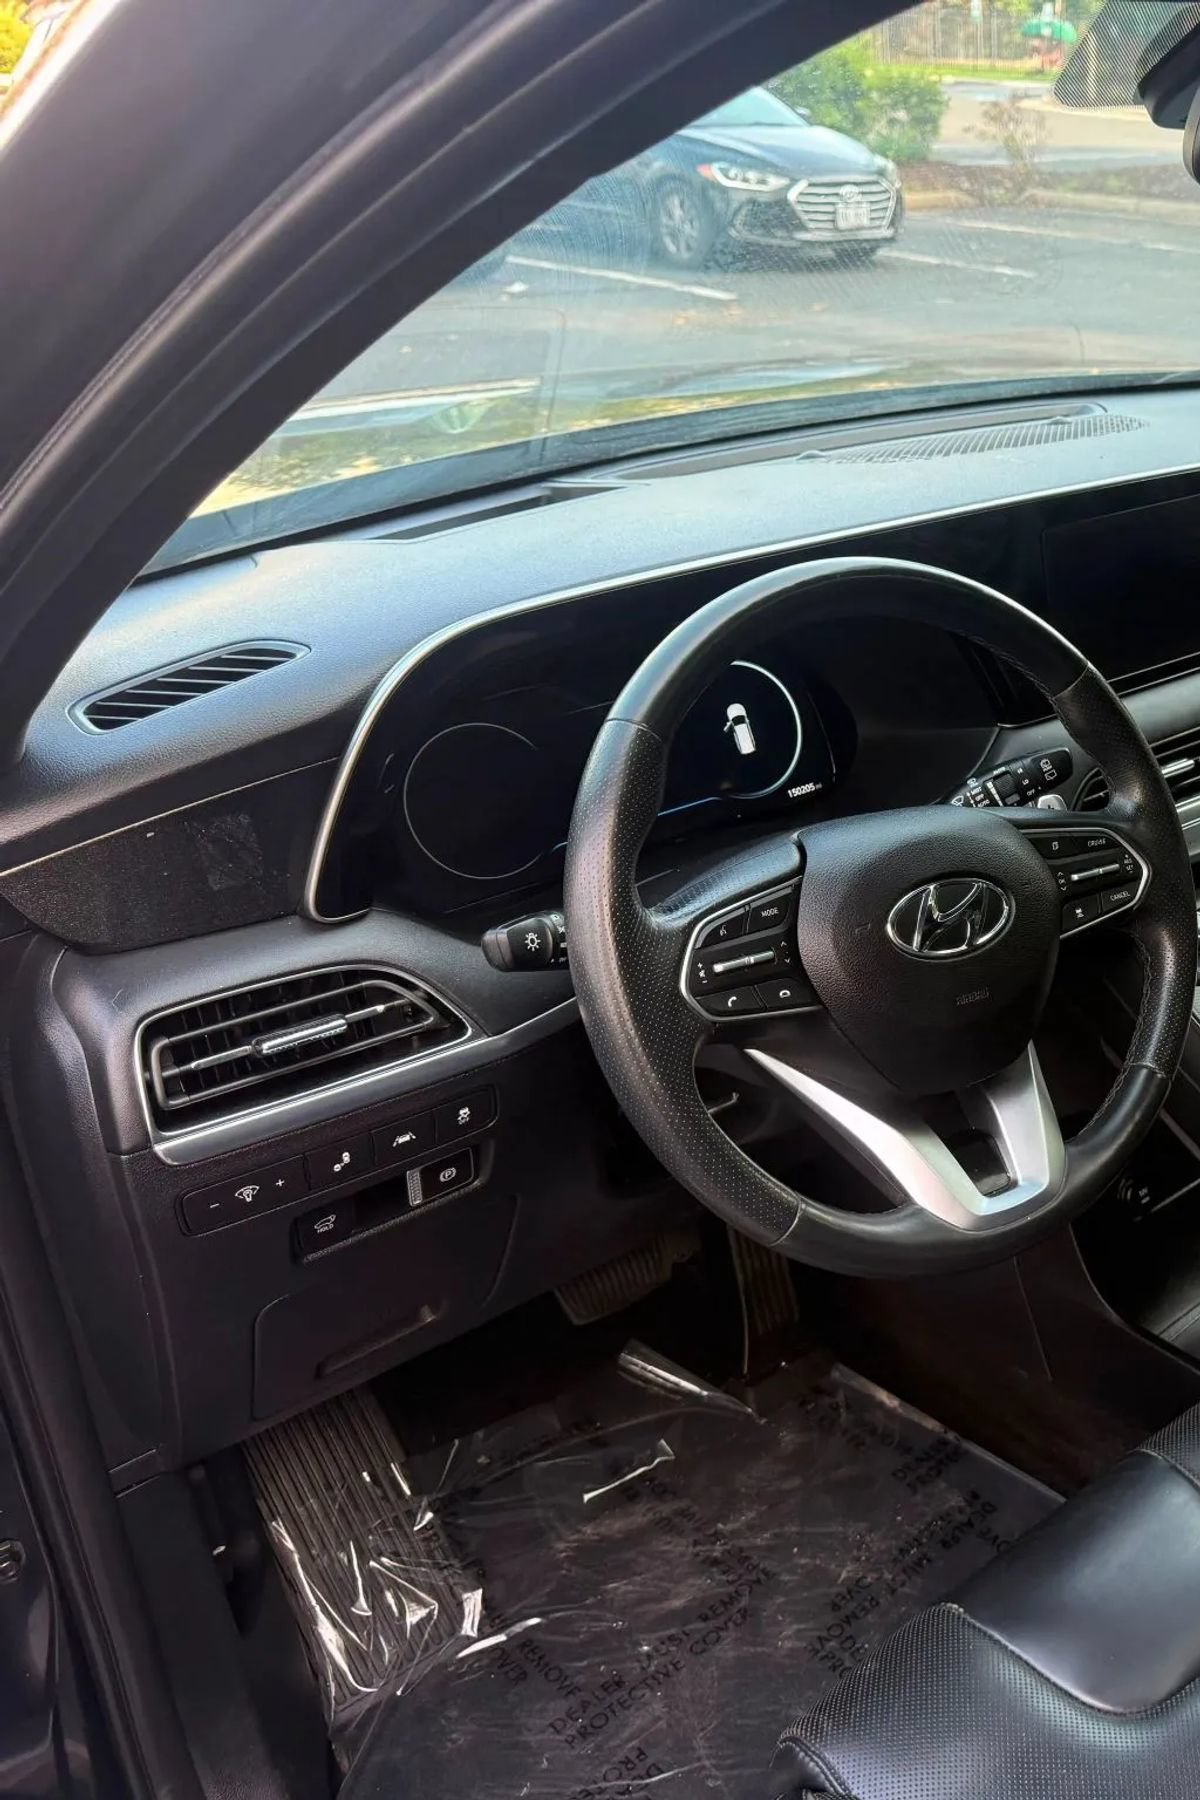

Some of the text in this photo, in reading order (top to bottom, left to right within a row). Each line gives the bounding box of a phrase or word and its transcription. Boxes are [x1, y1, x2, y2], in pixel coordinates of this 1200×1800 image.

[1109, 890, 1131, 901] CANCEL
[761, 906, 779, 917] MODE
[317, 1223, 334, 1233] HOLD
[564, 1606, 749, 1749] PROTECTIVE COVER
[547, 1672, 627, 1735] DEALER
